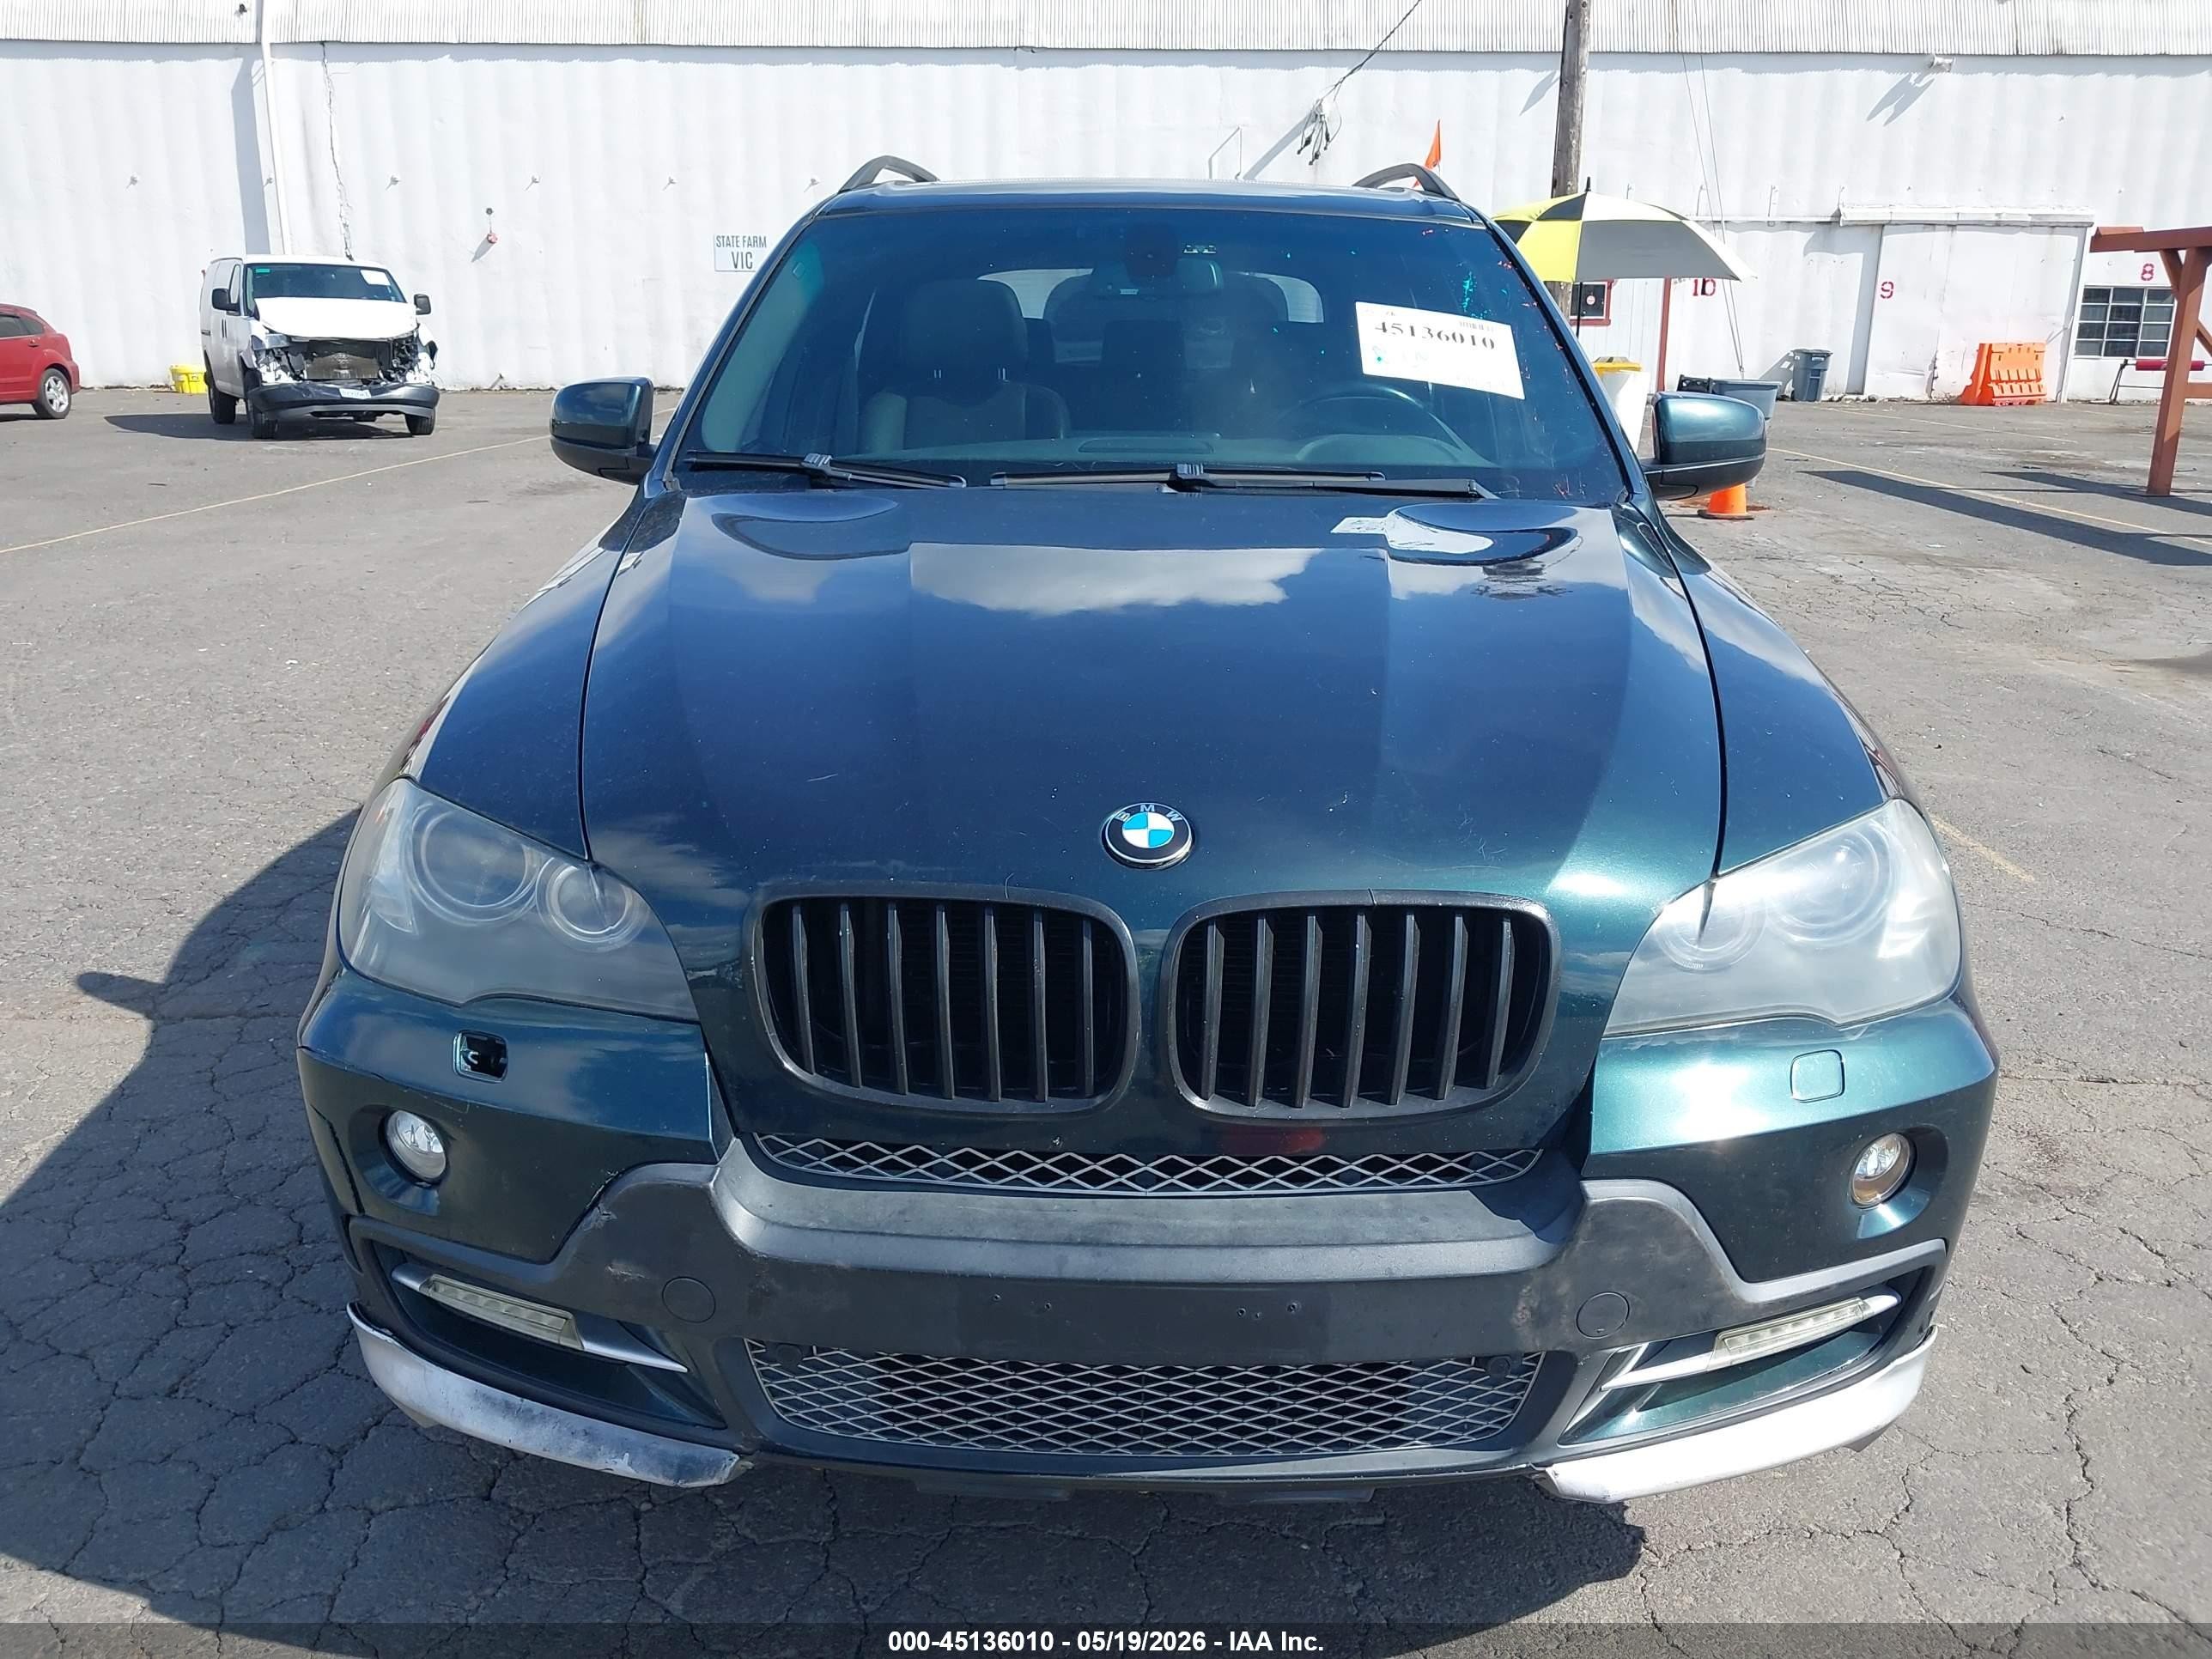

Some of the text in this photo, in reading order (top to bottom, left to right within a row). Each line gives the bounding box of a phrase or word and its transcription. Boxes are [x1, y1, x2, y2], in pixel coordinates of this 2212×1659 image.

[715, 234, 768, 248] STATE FARM
[731, 251, 753, 270] VIC
[2141, 263, 2154, 282] 8
[1880, 281, 1894, 300] 9
[1375, 321, 1495, 349] 45136010
[1115, 804, 1183, 823] BMW
